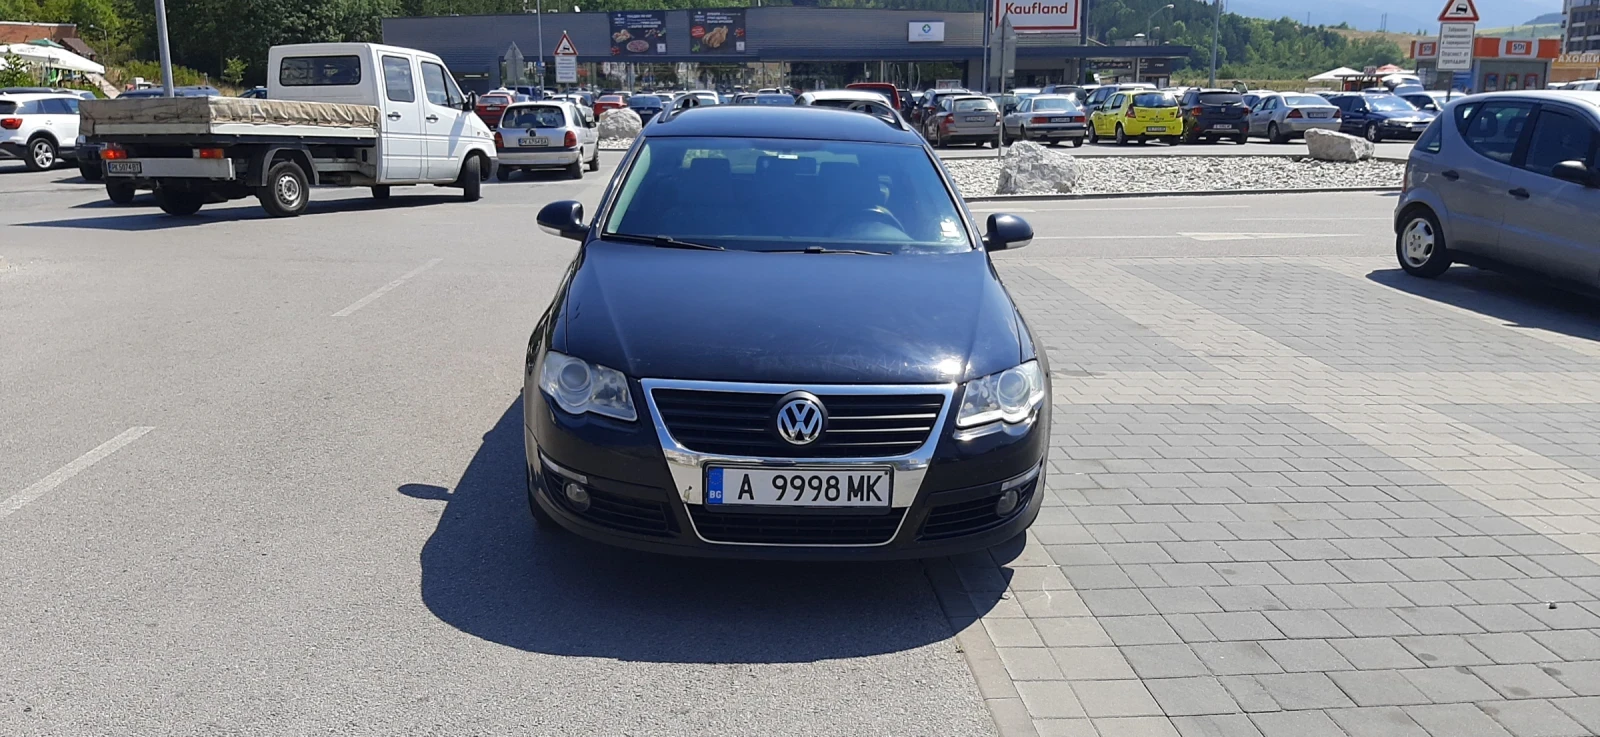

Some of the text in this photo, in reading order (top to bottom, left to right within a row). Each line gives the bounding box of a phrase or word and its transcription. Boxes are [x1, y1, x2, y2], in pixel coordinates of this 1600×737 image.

[1005, 2, 1068, 14] Kaufland
[737, 473, 882, 502] A 9998 MK
[709, 490, 722, 499] BG
